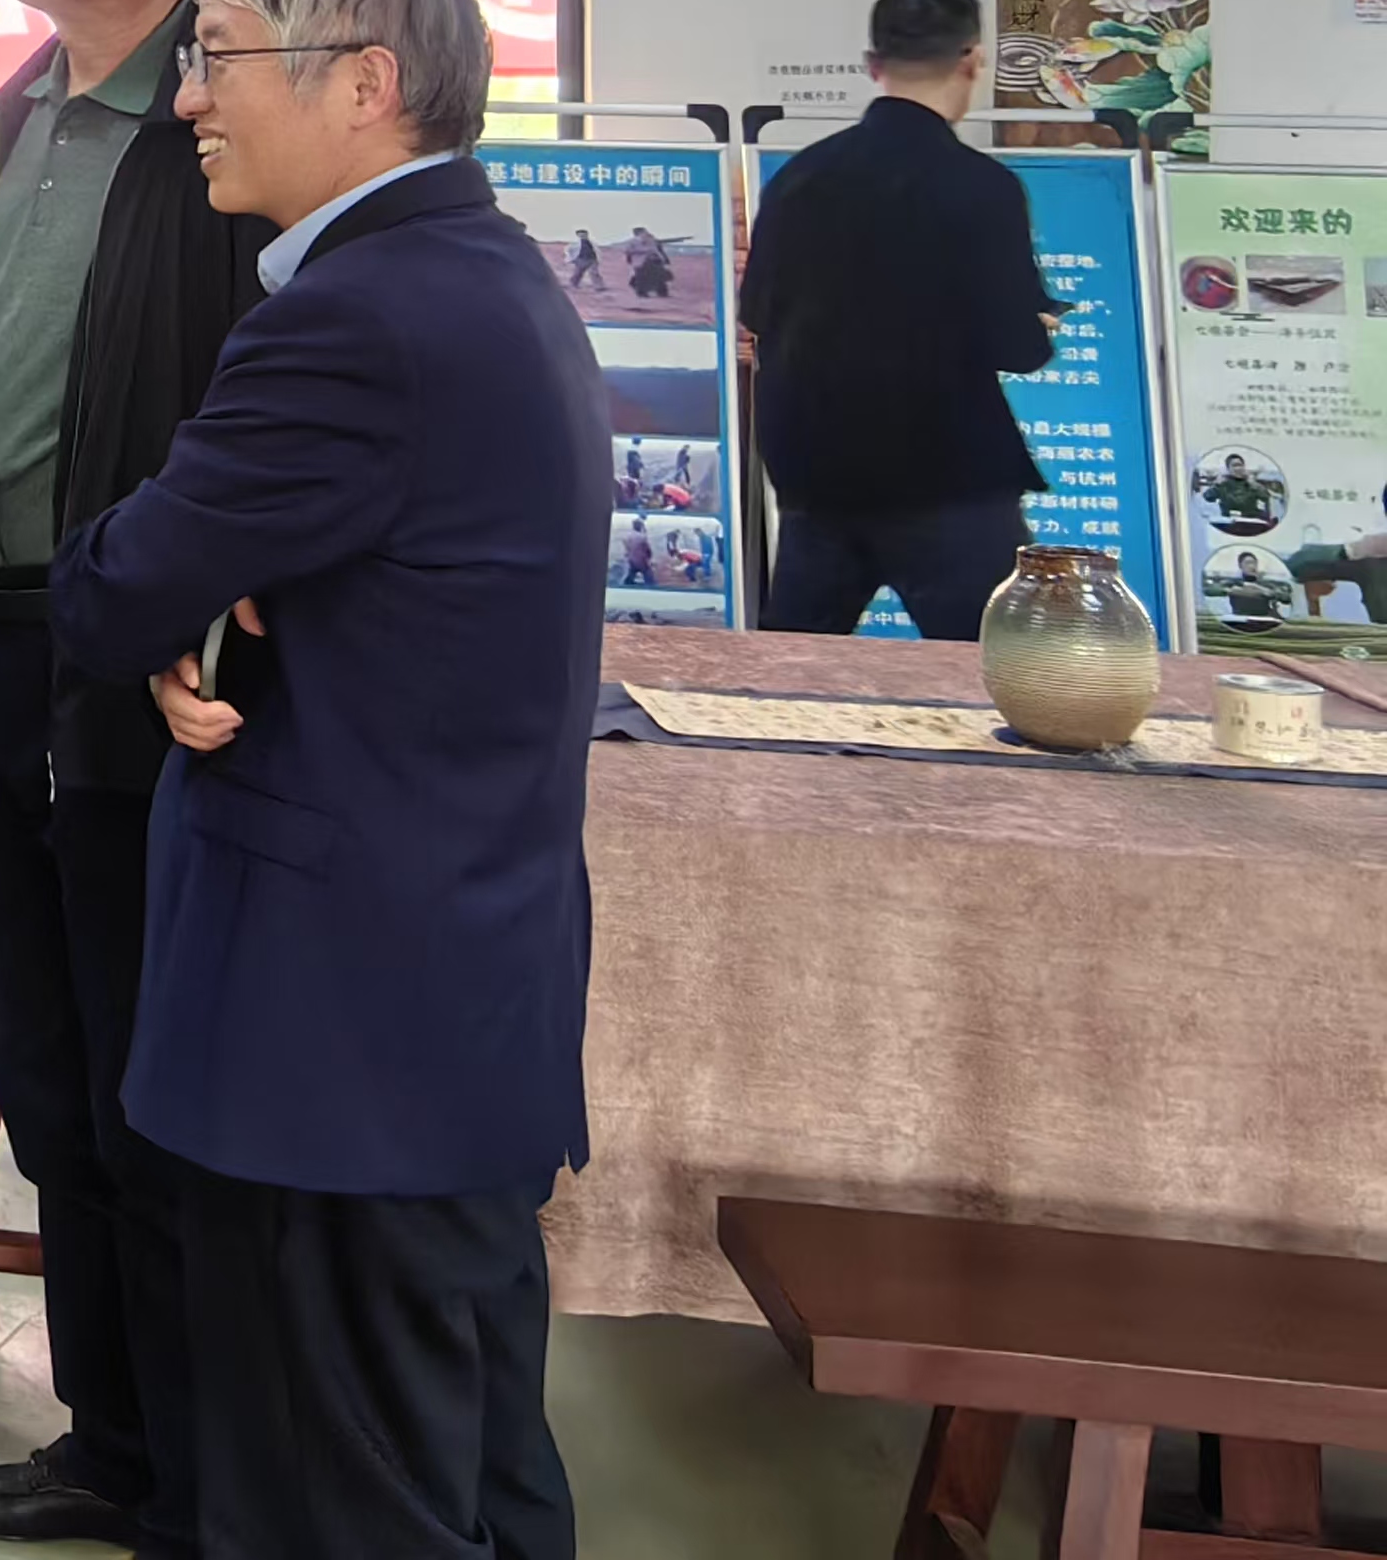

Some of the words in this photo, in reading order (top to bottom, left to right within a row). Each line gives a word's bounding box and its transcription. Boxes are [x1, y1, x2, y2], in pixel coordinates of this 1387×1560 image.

[486, 161, 691, 187] 基地建设中的瞬间
